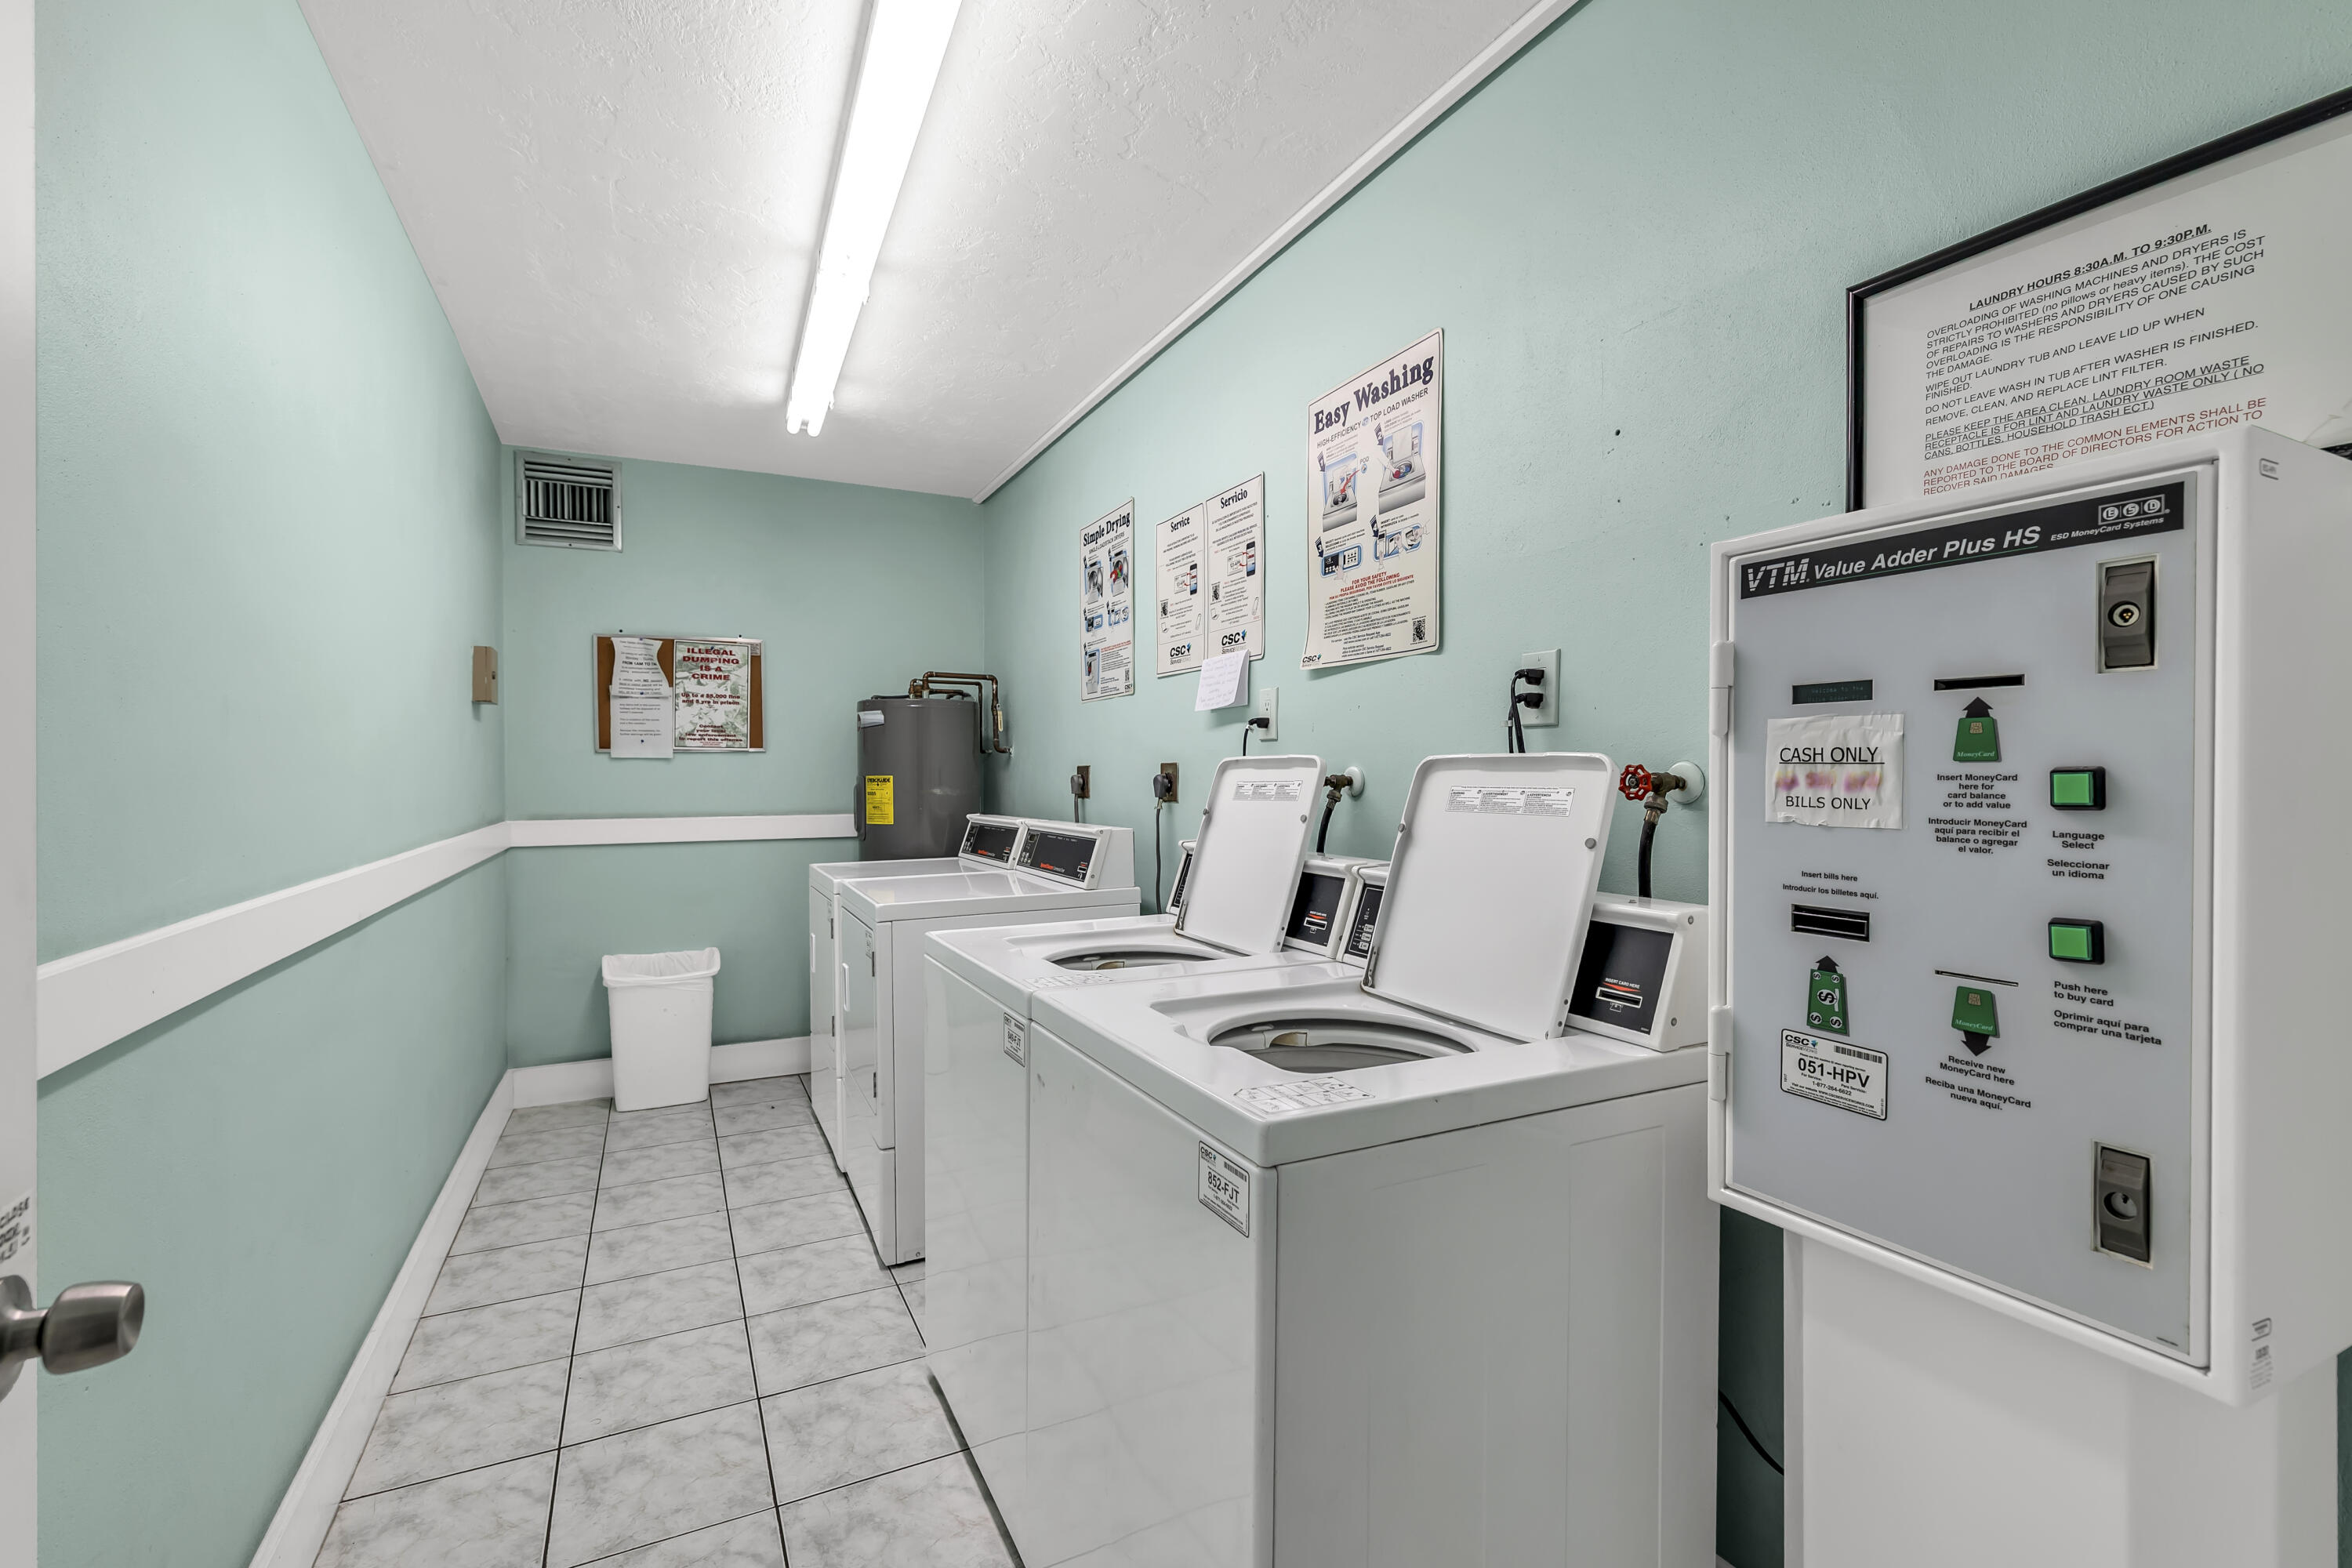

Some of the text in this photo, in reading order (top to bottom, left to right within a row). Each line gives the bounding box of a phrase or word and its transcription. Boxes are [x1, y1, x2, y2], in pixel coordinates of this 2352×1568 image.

[1969, 223, 2211, 310] LAUNDRY HOURS 8:30A.M. TO 9:30P.M.
[1926, 229, 2245, 338] OVERLOADING OF WASHING MACHINES AND DRYERS IS
[1926, 235, 2265, 348] STRICTLY PROHIBITED (no pillows or heavy items). THE COST
[1926, 307, 2204, 392] WIPE OUT LAUNDRY TUB AND LEAVE LID UP WHEN
[1314, 401, 1351, 434] Easy
[1354, 356, 1434, 412] Washing
[1926, 382, 1972, 401] FINISHED.
[1317, 421, 1362, 448] HIGH-EFFICIENCY
[1370, 412, 1382, 422] TOP
[1383, 402, 1400, 416] LOAD
[1402, 387, 1428, 407] WASHER
[1924, 400, 2154, 459] CANS, BOTTLES, HOUSEHOLD TRASH ECT.)
[1923, 480, 1969, 495] RECOVER
[1220, 488, 1248, 509] Servicio
[1083, 524, 1105, 546] Simple
[1106, 512, 1130, 535] Drying
[1171, 516, 1190, 532] Service
[2050, 517, 2165, 541] ESD MoneyCard Systems
[1748, 525, 2042, 591] VTM Value Adder Plus HS
[1372, 572, 1387, 580] SAFETY
[1376, 573, 1400, 584] FOLLOWING
[1221, 633, 1240, 646] CSC
[1170, 645, 1185, 657] CSC
[683, 655, 739, 664] DUMPING
[1780, 746, 1878, 762] CASH ONLY
[1965, 774, 2018, 782] MoneyCard
[1786, 796, 1871, 810] BILLS ONLY
[1973, 819, 2027, 828] MoneyCard
[2053, 830, 2104, 841] Language
[2062, 840, 2094, 849] Select
[2047, 858, 2110, 869] Seleccionar
[2068, 869, 2104, 879] idioma
[1783, 884, 1816, 892] Introducir
[1831, 888, 1857, 897] billetes
[2054, 981, 2108, 996] Push here
[2067, 993, 2086, 1004] buy
[2090, 997, 2114, 1007] card
[1955, 1019, 1994, 1031] MoneyCard
[2054, 1010, 2150, 1033] Oprimir aquí para
[1785, 1035, 1809, 1046] CSC
[2054, 1021, 2161, 1045] comprar una tarjeta
[1798, 1058, 1870, 1087] 051-HPV
[1948, 1055, 2005, 1074] Receive new
[1940, 1062, 2015, 1085] MoneyCard here
[1926, 1076, 2031, 1108] Reciba una MoneyCard
[1951, 1093, 2002, 1110] nueva aquí.
[1200, 1147, 1213, 1159] CSC
[1208, 1171, 1240, 1203] 852-FJT
